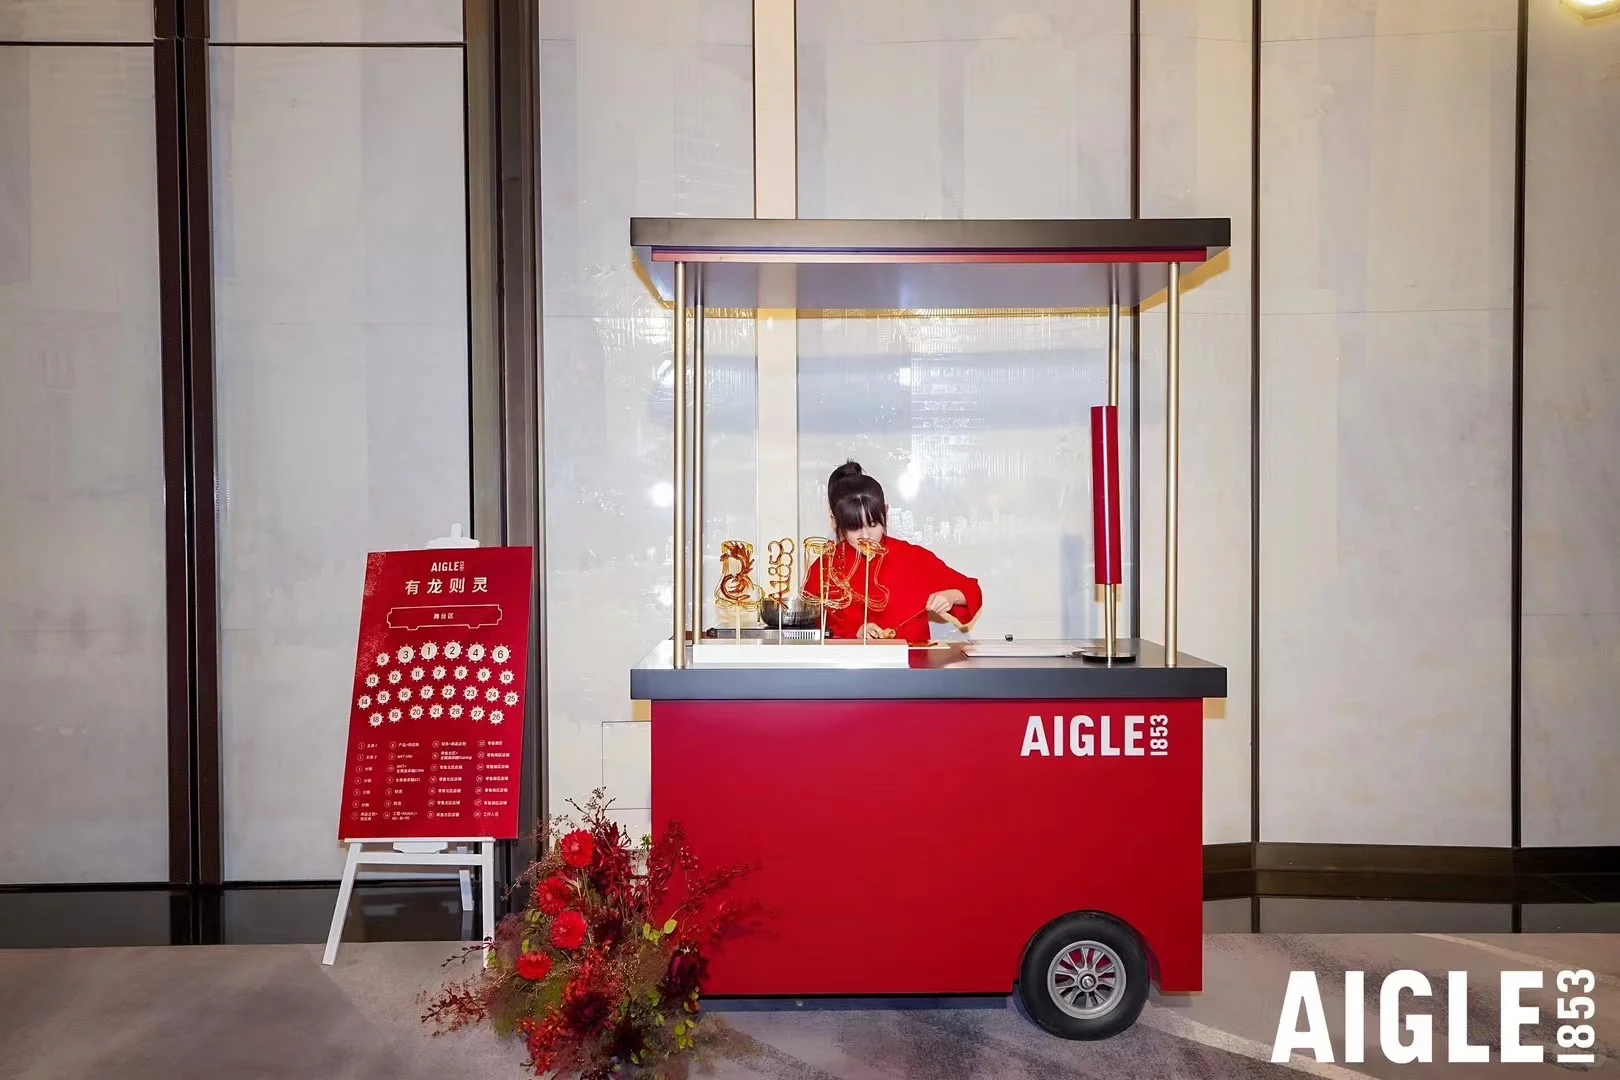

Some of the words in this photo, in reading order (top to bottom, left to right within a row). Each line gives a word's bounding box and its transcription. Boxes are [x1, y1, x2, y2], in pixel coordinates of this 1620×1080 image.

[431, 562, 459, 572] AIGLE
[405, 577, 488, 595] 有龙则灵
[403, 650, 409, 658] 3
[450, 646, 455, 654] 2
[473, 649, 479, 657] 4
[498, 650, 504, 658] 6
[1020, 716, 1146, 757] AIGLE
[1150, 714, 1168, 756] 1853
